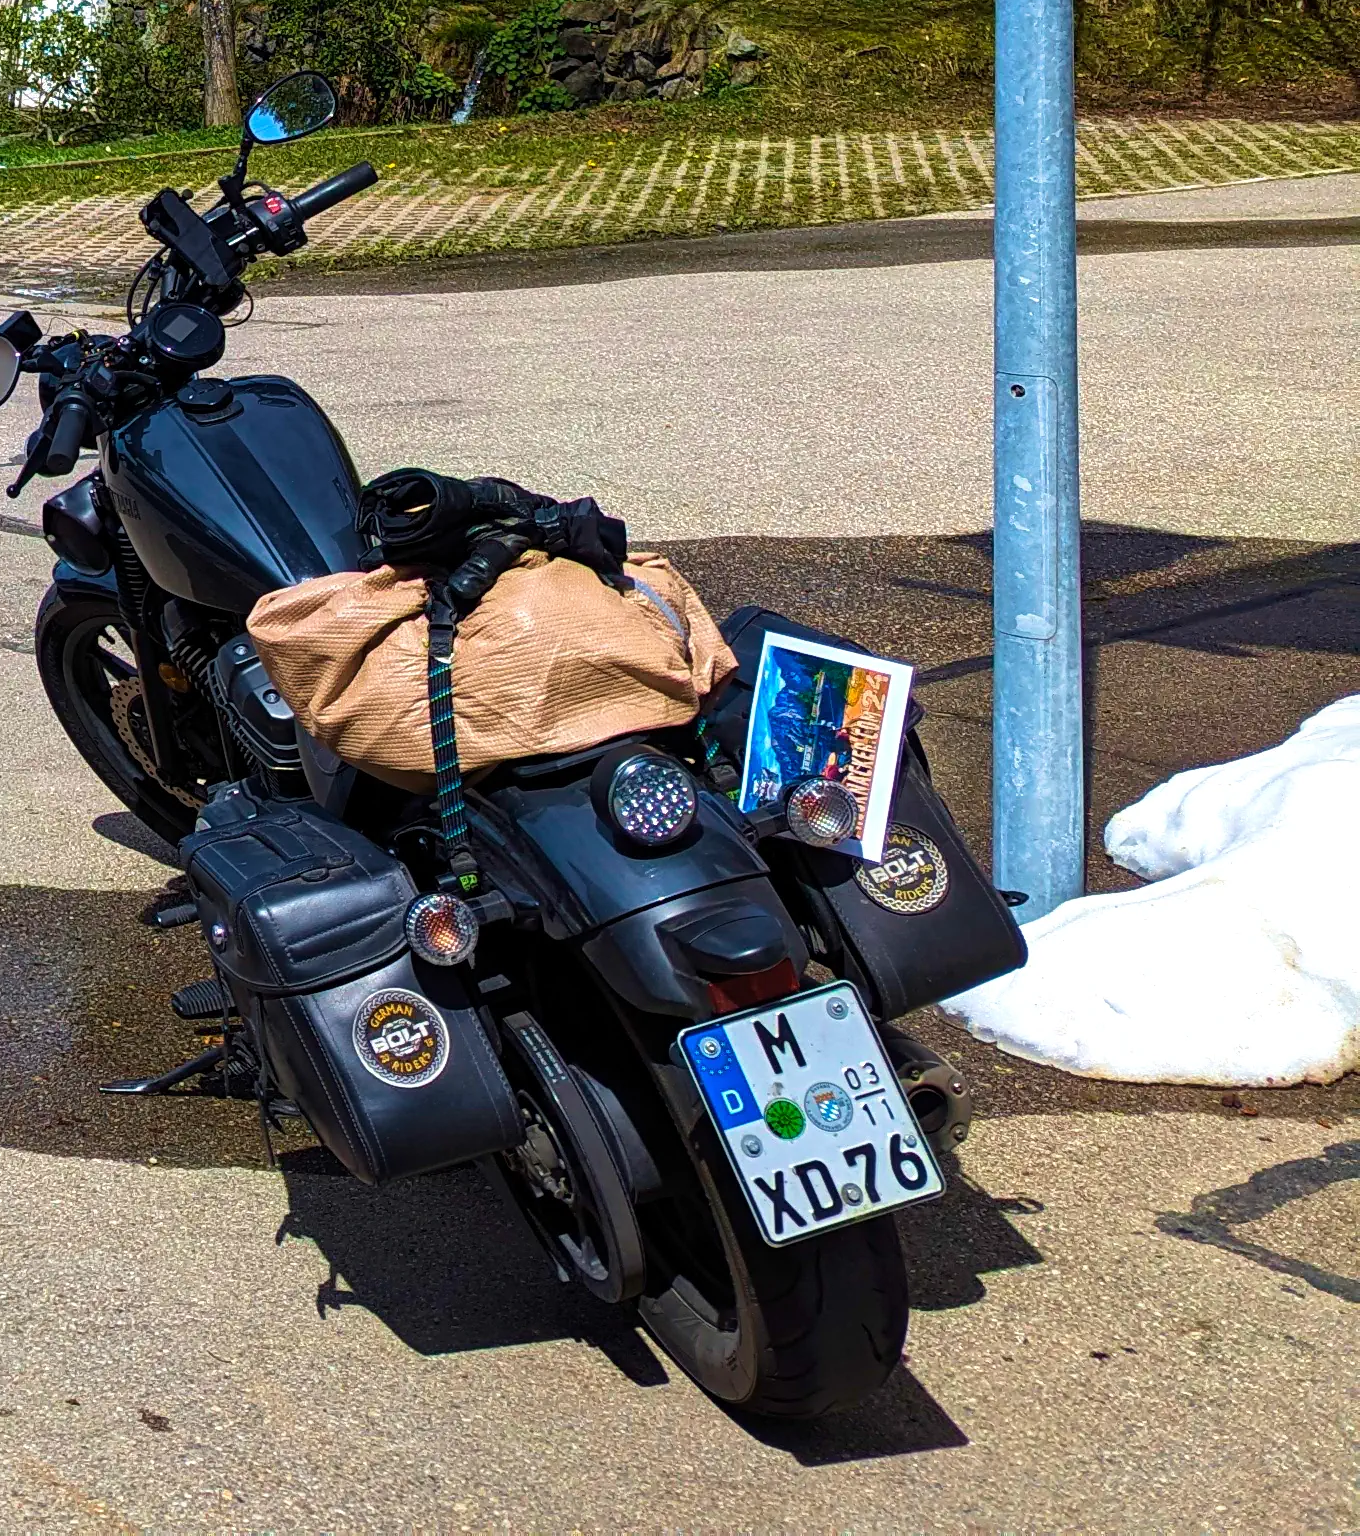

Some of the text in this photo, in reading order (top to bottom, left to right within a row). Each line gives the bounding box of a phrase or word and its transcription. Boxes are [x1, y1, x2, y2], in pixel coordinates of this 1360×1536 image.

[868, 850, 925, 884] BOLT
[895, 876, 934, 900] RIDERS
[370, 1003, 413, 1028] GERMAN
[370, 1020, 430, 1055] BOLT
[752, 1012, 807, 1075] M
[391, 1051, 432, 1073] RIDERS
[843, 1062, 880, 1091] 03
[721, 1089, 744, 1114] D
[860, 1097, 896, 1126] 11
